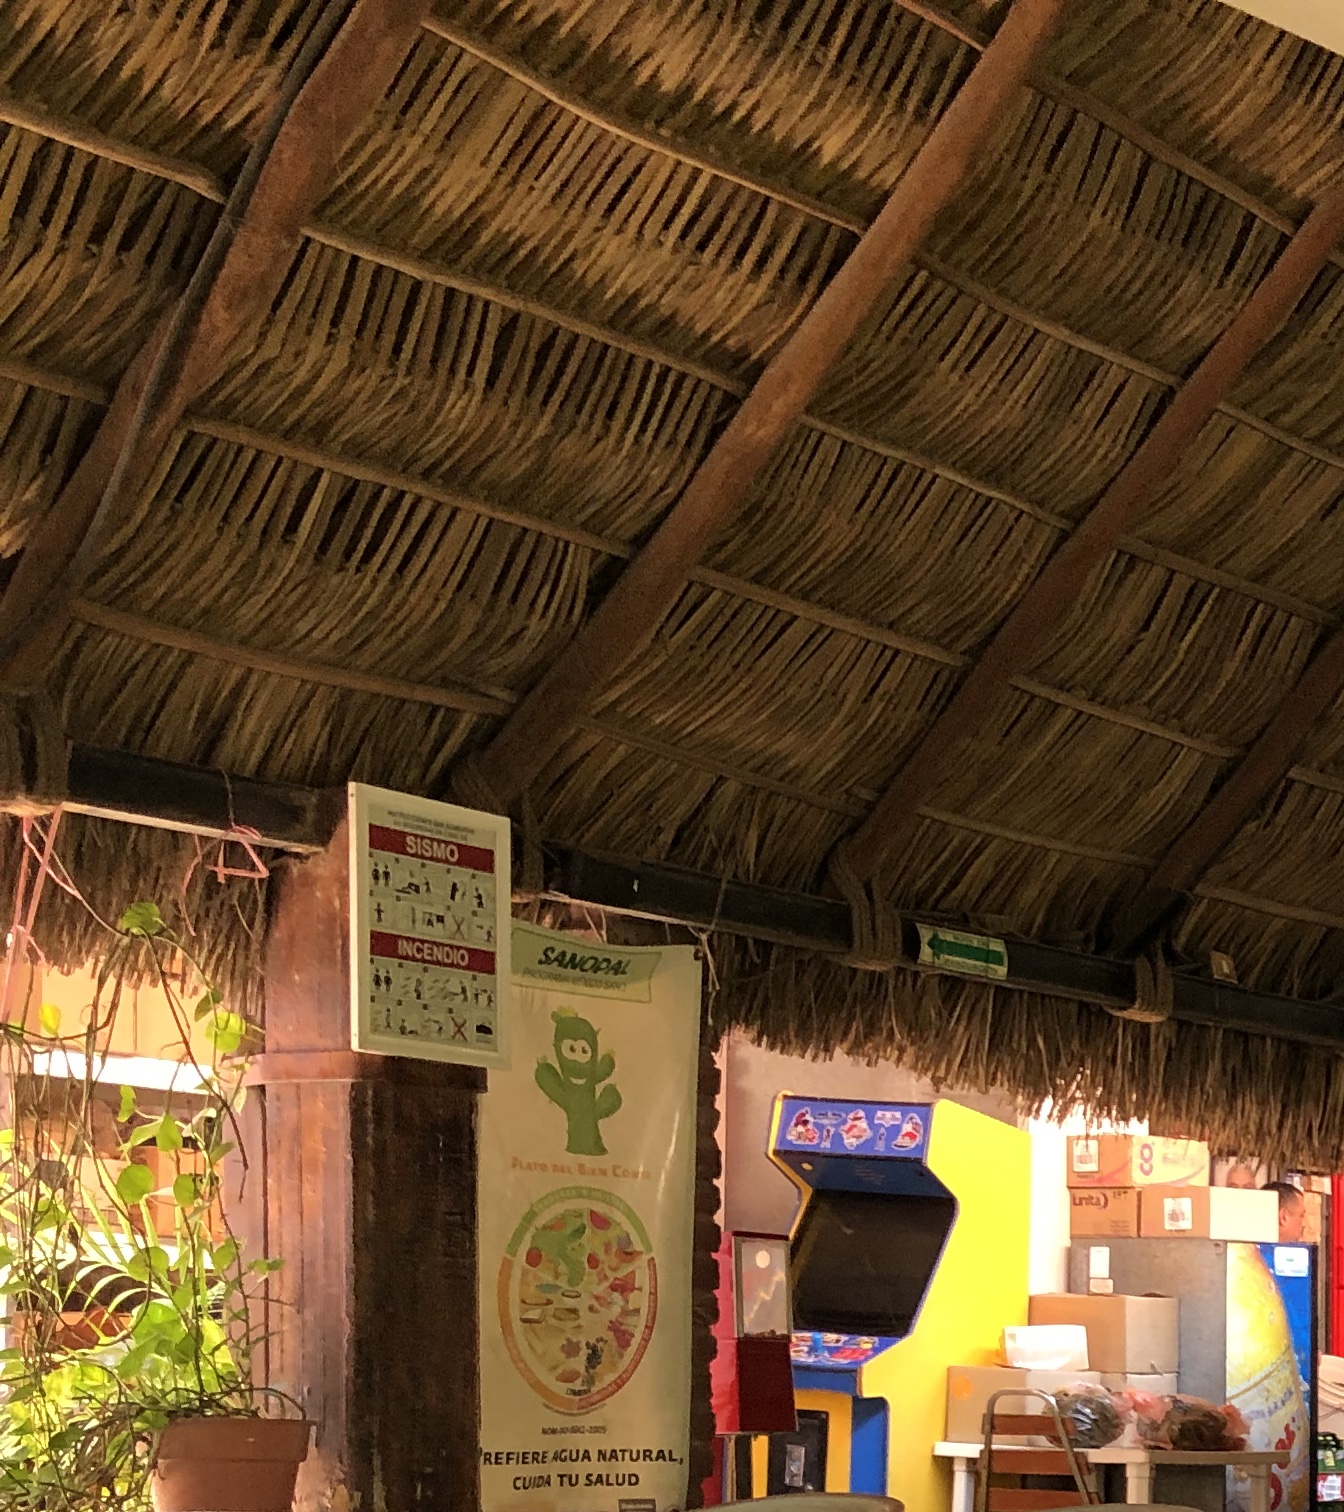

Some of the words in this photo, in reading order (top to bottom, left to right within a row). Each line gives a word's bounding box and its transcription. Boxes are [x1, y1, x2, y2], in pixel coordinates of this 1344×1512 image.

[405, 835, 459, 862] SISMO
[398, 938, 469, 967] INCENDIO
[537, 946, 631, 976] SANOPAL
[482, 1451, 548, 1466] REFIERE
[552, 1449, 591, 1463] AGUA
[596, 1449, 684, 1465] NATURAL,
[513, 1474, 551, 1490] CUIDA
[557, 1473, 579, 1487] TU
[584, 1472, 640, 1487] SALUD
